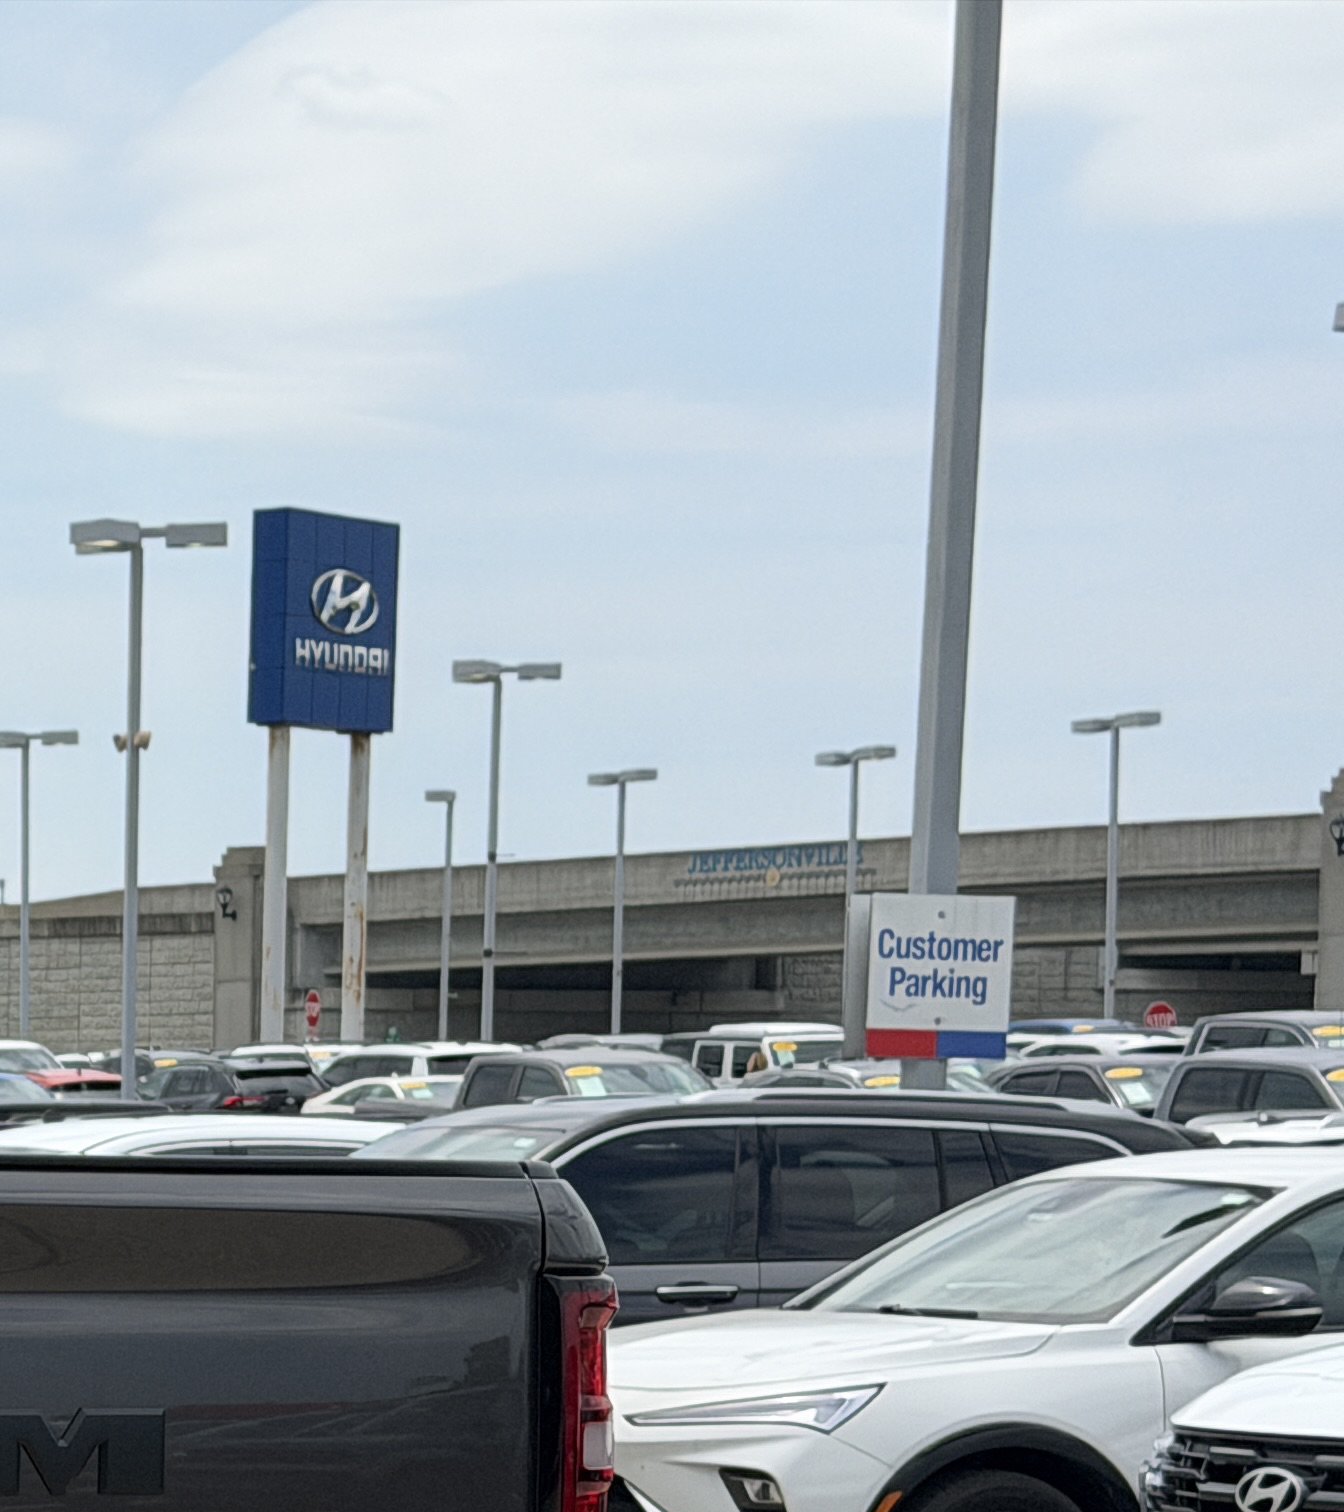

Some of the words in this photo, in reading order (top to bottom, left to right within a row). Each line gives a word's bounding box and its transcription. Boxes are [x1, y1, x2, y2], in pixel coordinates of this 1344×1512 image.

[295, 637, 389, 676] HYUNDAI
[878, 928, 1004, 962] Customer
[888, 966, 988, 1006] Parking
